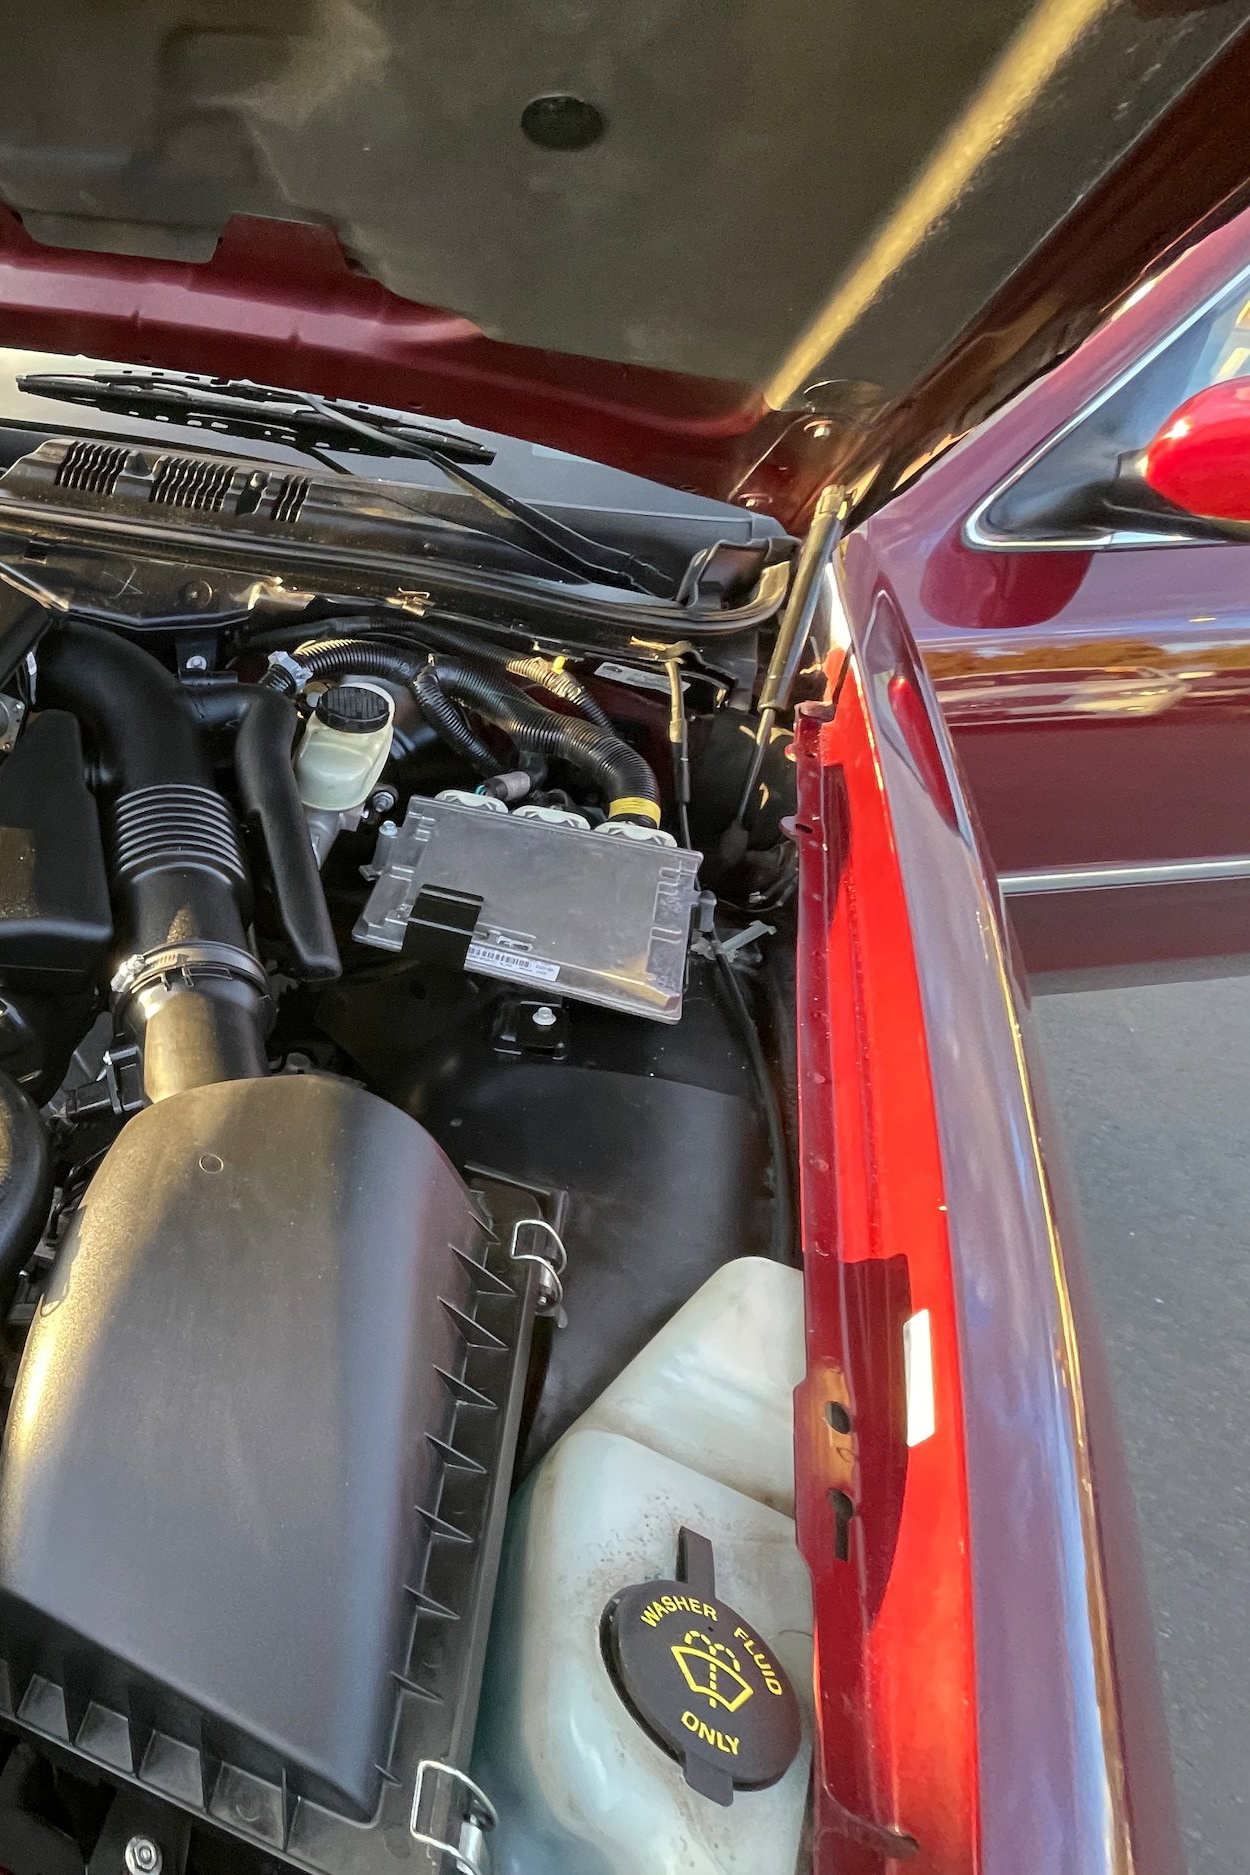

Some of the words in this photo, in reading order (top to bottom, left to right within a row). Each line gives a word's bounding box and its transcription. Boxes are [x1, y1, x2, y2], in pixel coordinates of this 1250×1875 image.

[640, 1595, 718, 1628] WASHER
[733, 1626, 783, 1696] FLUID
[680, 1710, 740, 1756] ONLY
